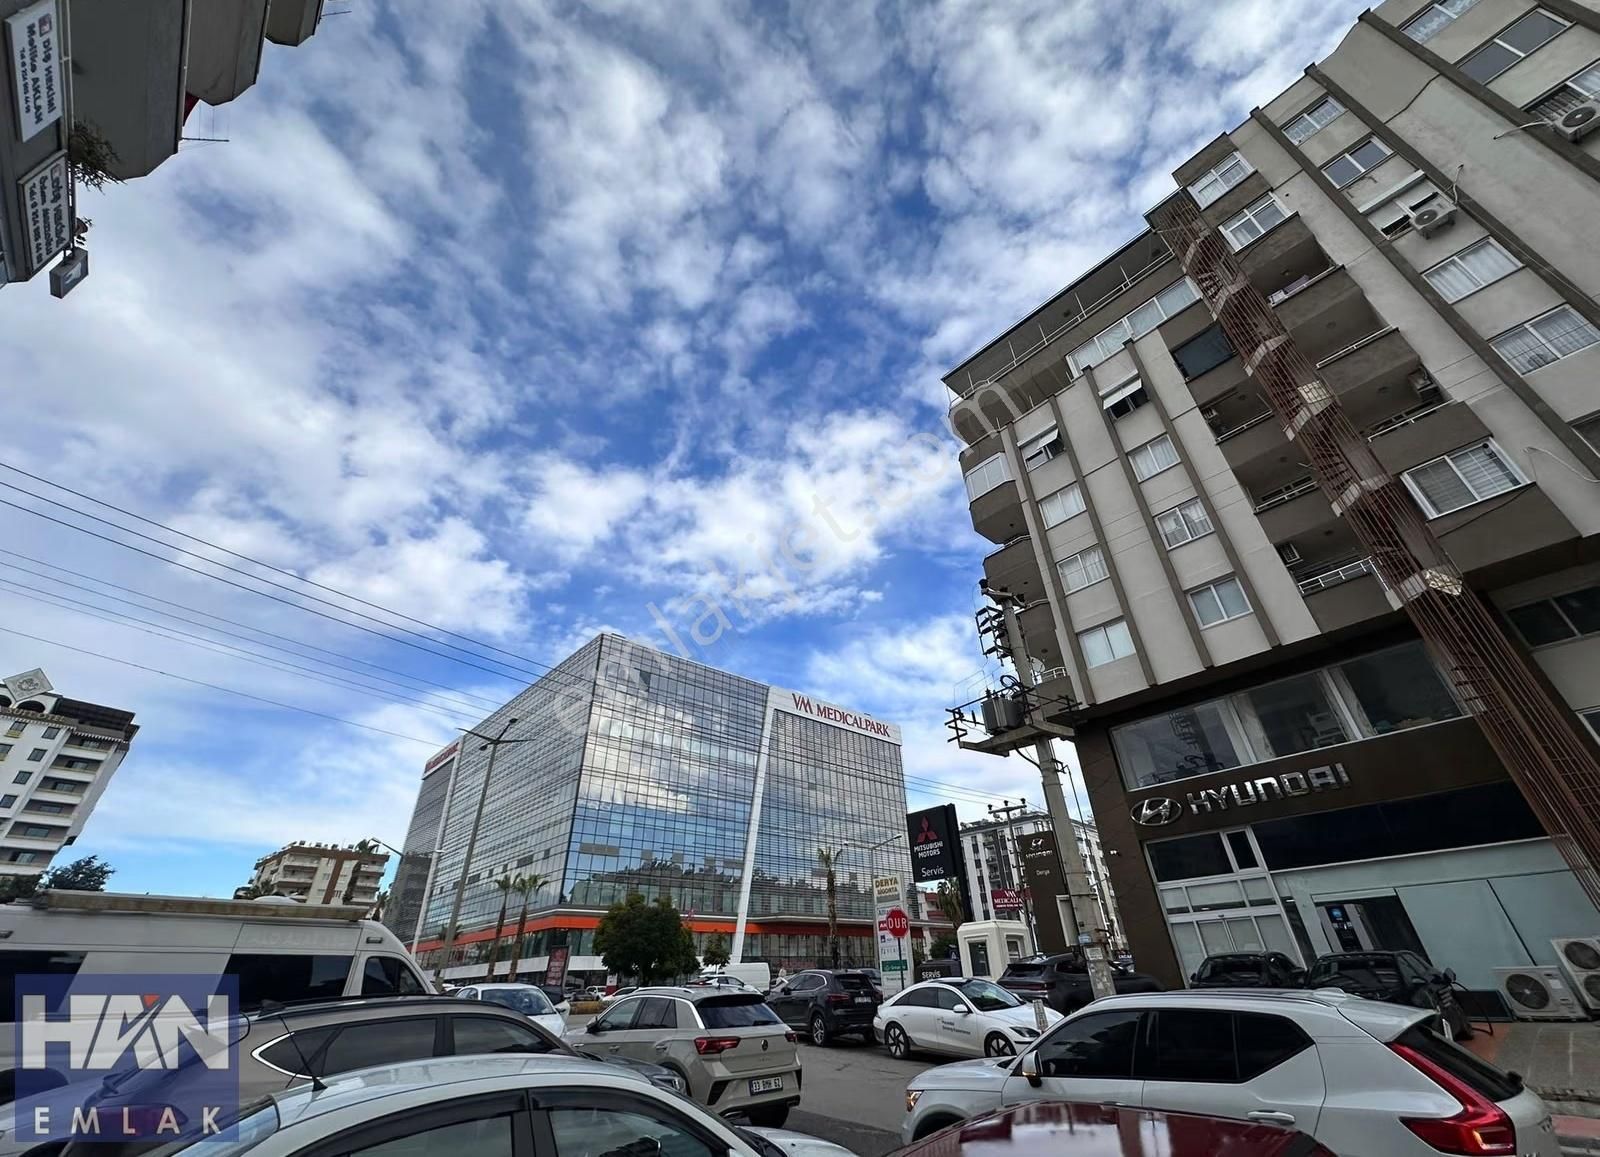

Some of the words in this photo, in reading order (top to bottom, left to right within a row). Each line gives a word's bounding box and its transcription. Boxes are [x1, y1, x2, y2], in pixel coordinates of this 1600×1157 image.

[792, 693, 814, 714] VM
[816, 703, 891, 738] MEDICALPARK
[1185, 762, 1351, 815] HYUNDAI
[914, 841, 944, 853] MITSUBISHI
[918, 848, 941, 859] MOTORS
[921, 865, 944, 878] Servis
[875, 877, 898, 889] DERYA
[887, 917, 908, 929] DUR
